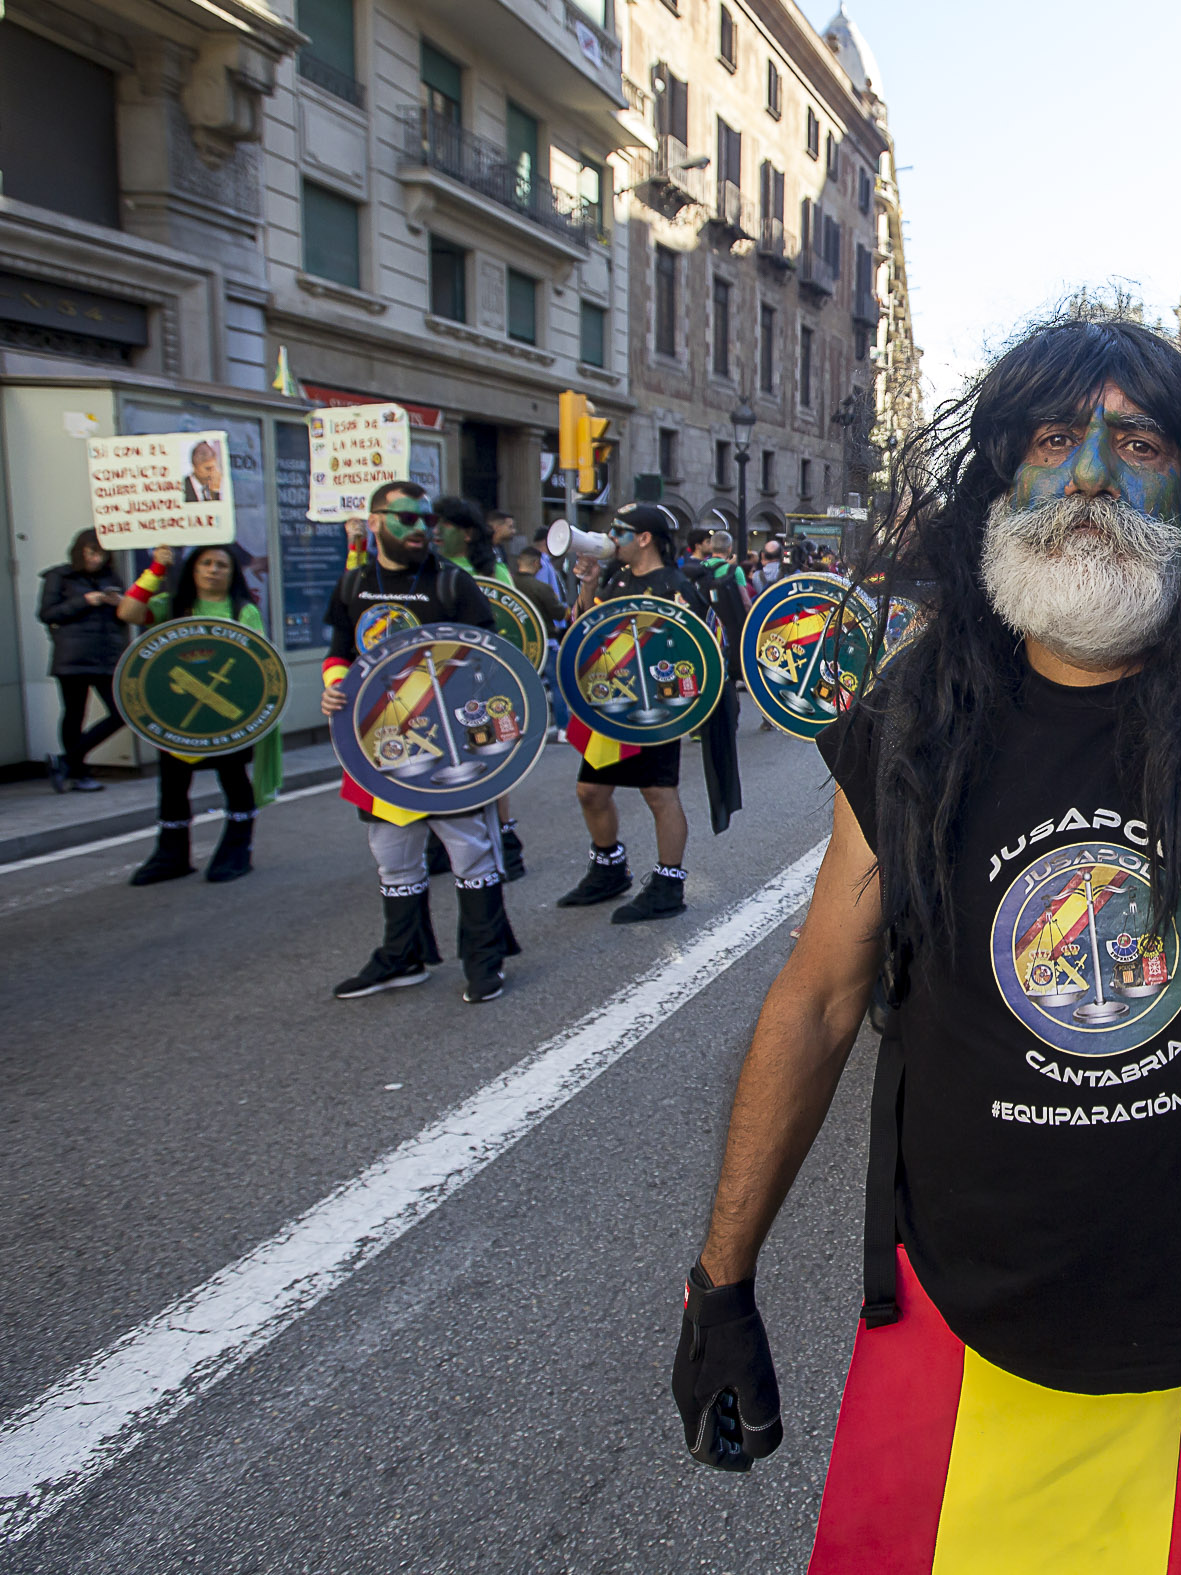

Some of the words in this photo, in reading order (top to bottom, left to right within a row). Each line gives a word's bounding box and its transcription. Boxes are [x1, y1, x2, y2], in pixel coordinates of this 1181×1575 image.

[113, 444, 142, 458] CON
[332, 439, 346, 451] LA
[92, 464, 169, 482] CONFLICTO
[95, 483, 138, 498] QUIERE
[95, 503, 121, 516] CON
[124, 499, 183, 515] JUSAPOL
[501, 595, 529, 624] CIVIL
[138, 625, 208, 659] GUARDIA
[211, 626, 250, 647] CIVIL
[163, 730, 210, 746] HONOR
[246, 703, 275, 733] DIVISA
[989, 807, 1164, 883] JUSAPO
[1024, 849, 1151, 896] JUSAPOL
